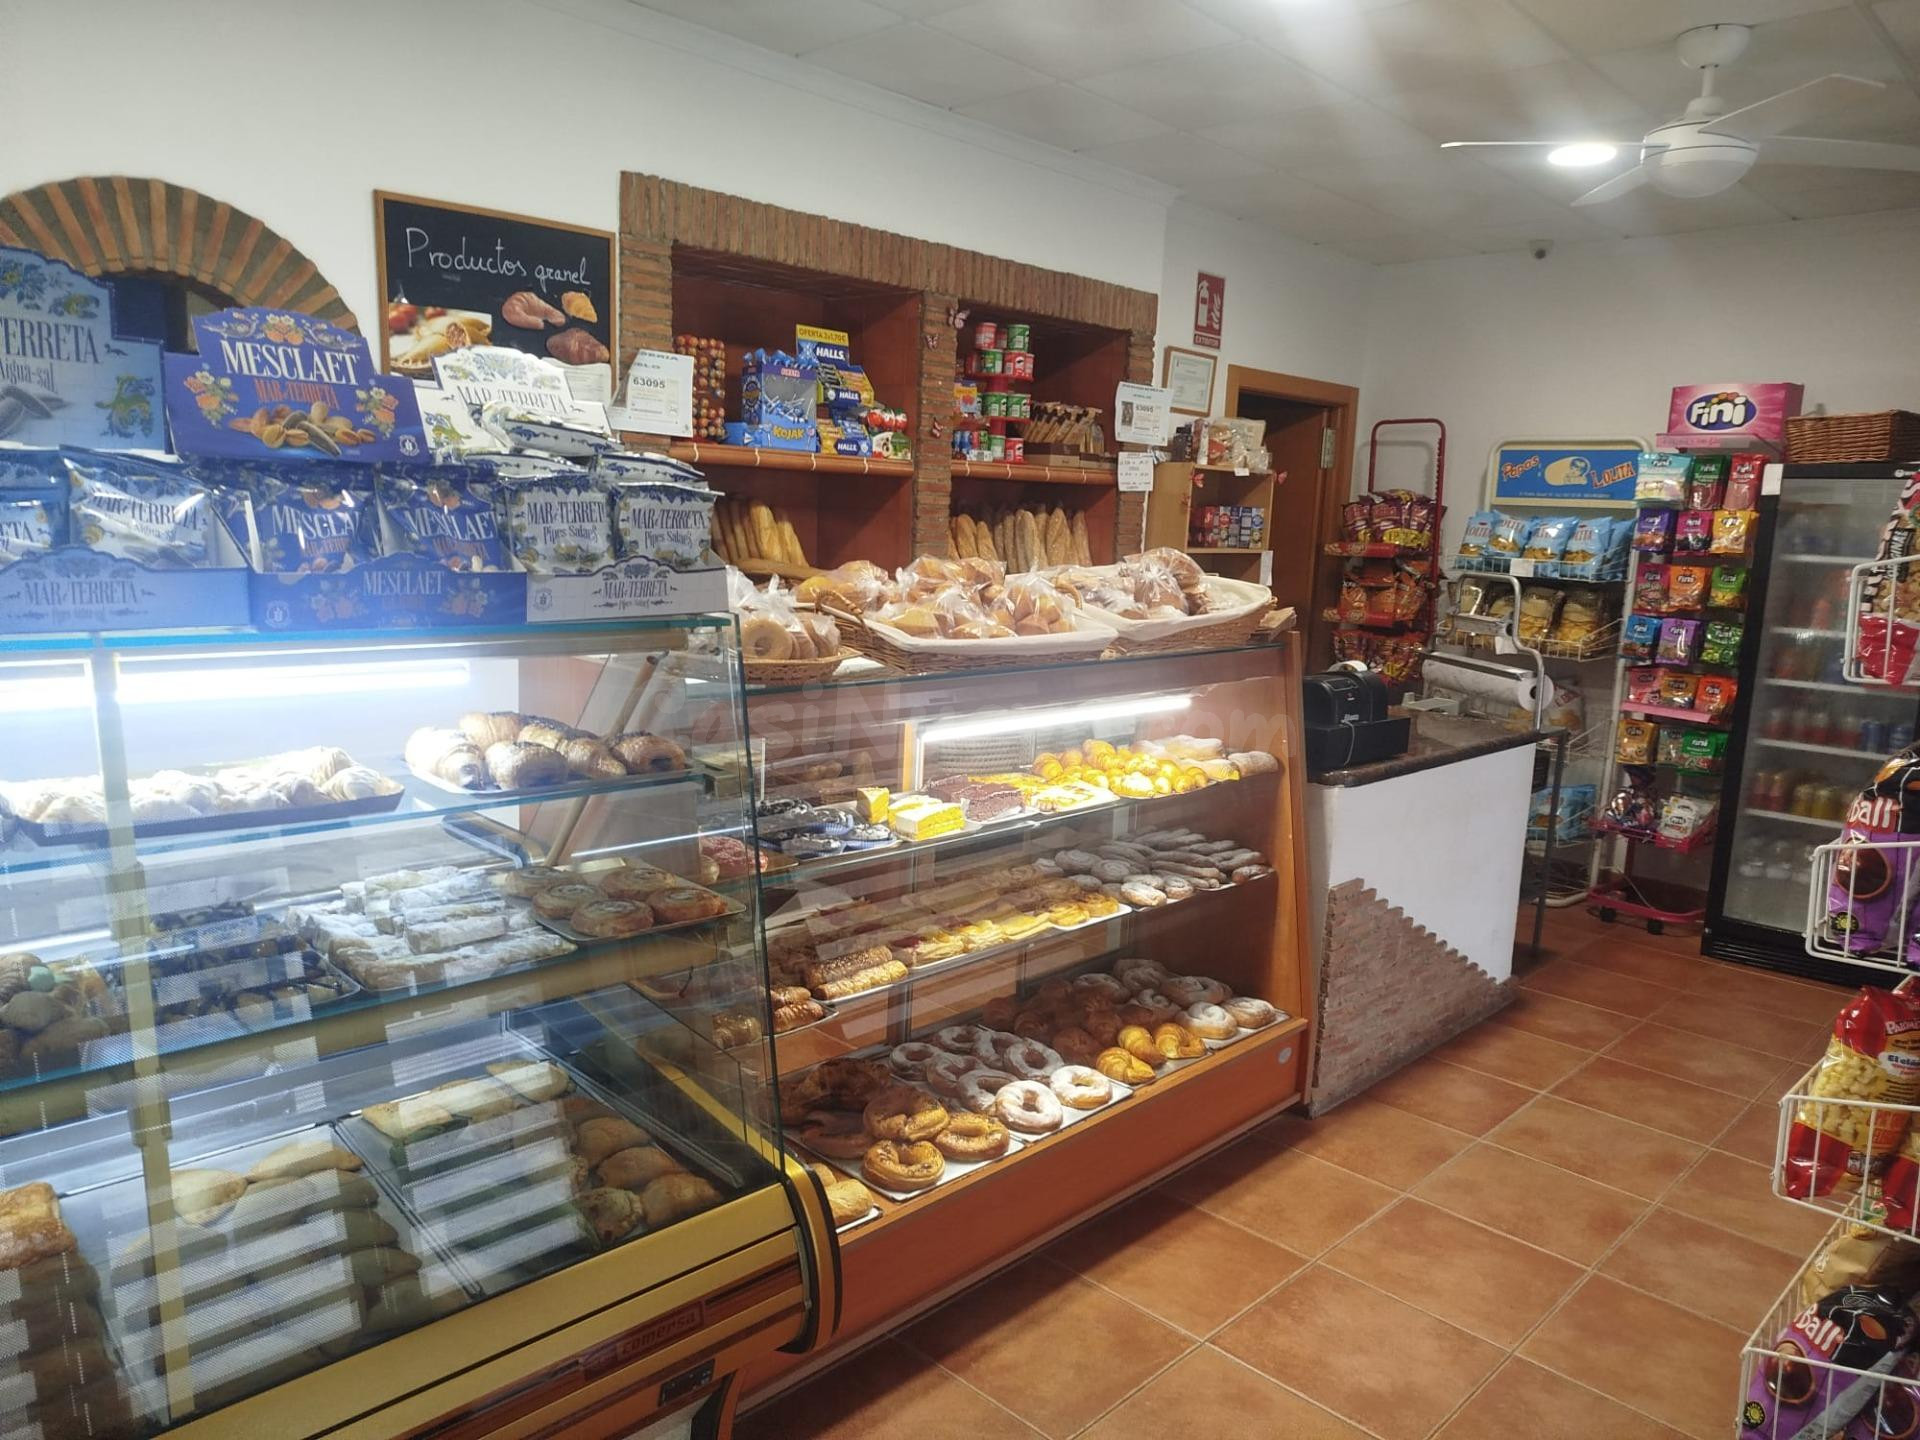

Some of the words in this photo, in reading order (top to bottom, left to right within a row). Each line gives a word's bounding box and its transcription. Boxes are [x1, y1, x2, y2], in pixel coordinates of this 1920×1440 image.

[405, 226, 527, 277] Productos
[534, 256, 591, 294] granel
[0, 317, 101, 364] ERRETA
[816, 346, 846, 361] HALLS
[219, 339, 360, 386] MESCLAET
[632, 376, 666, 390] 63095
[839, 390, 860, 400] HALLS
[1690, 395, 1747, 426] Fini
[771, 425, 805, 441] KOJAK
[836, 443, 858, 452] HALLS
[1590, 461, 1637, 489] LOLITA
[543, 525, 568, 545] Pipes
[69, 579, 139, 605] TERRETA
[363, 570, 445, 596] MESCLAET
